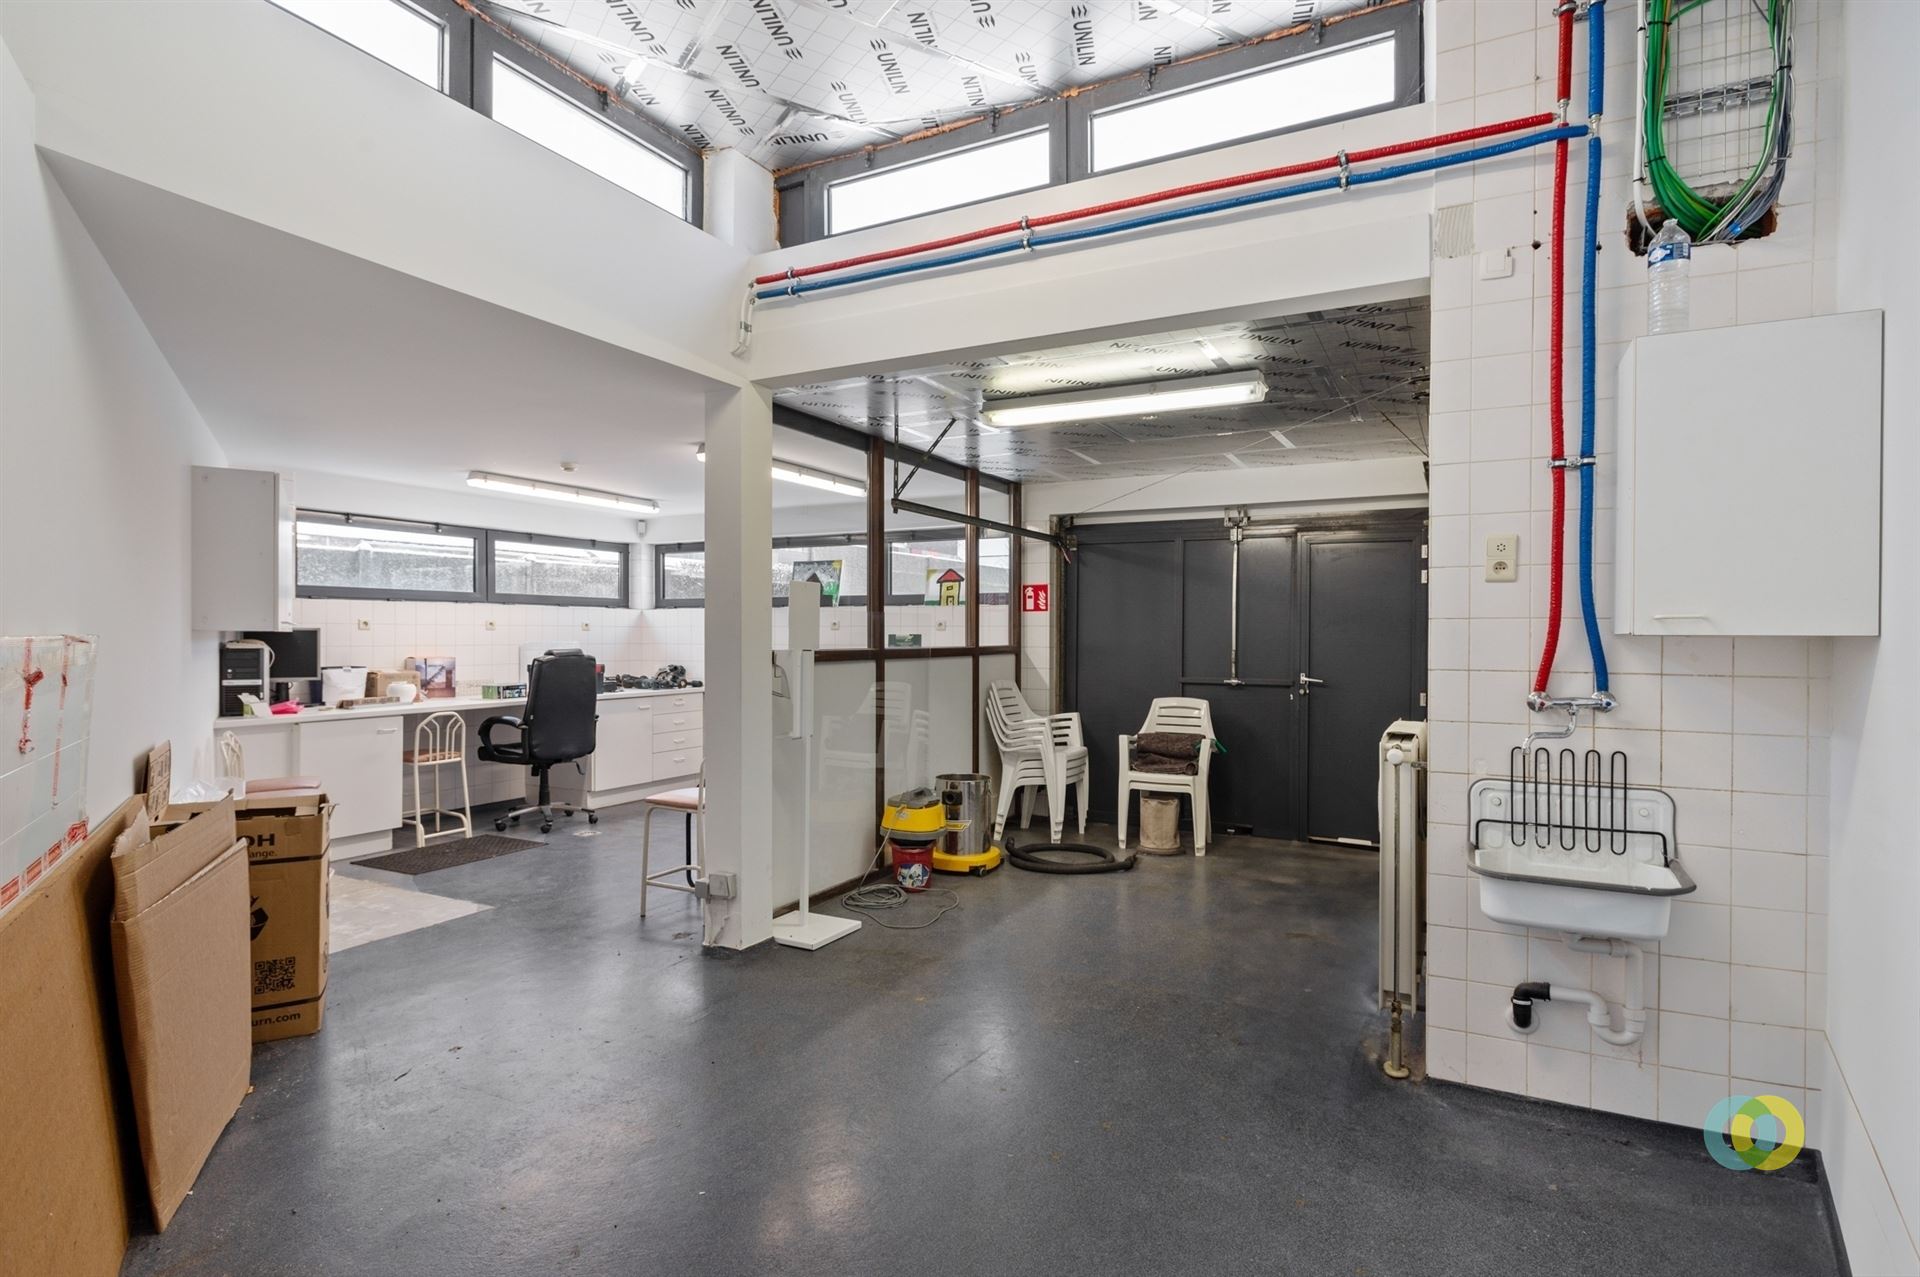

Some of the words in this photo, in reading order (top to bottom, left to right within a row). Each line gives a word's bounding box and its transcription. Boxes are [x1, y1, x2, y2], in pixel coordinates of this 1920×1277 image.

[907, 12, 938, 47] NILIN
[1073, 20, 1096, 66] UNILIN
[716, 45, 760, 88] UNILIN
[877, 52, 911, 94] UNILIN
[612, 66, 661, 106] UILIN
[961, 76, 986, 107] NILIN
[704, 89, 746, 126] UNILIN
[838, 93, 868, 124] UNILI
[679, 124, 715, 149] NILIN
[1238, 334, 1304, 345] UNILIN
[1339, 341, 1400, 352] UNILIN
[1254, 355, 1313, 365] UNILIN
[249, 850, 278, 859] ange.
[252, 1013, 301, 1027] urn.com
